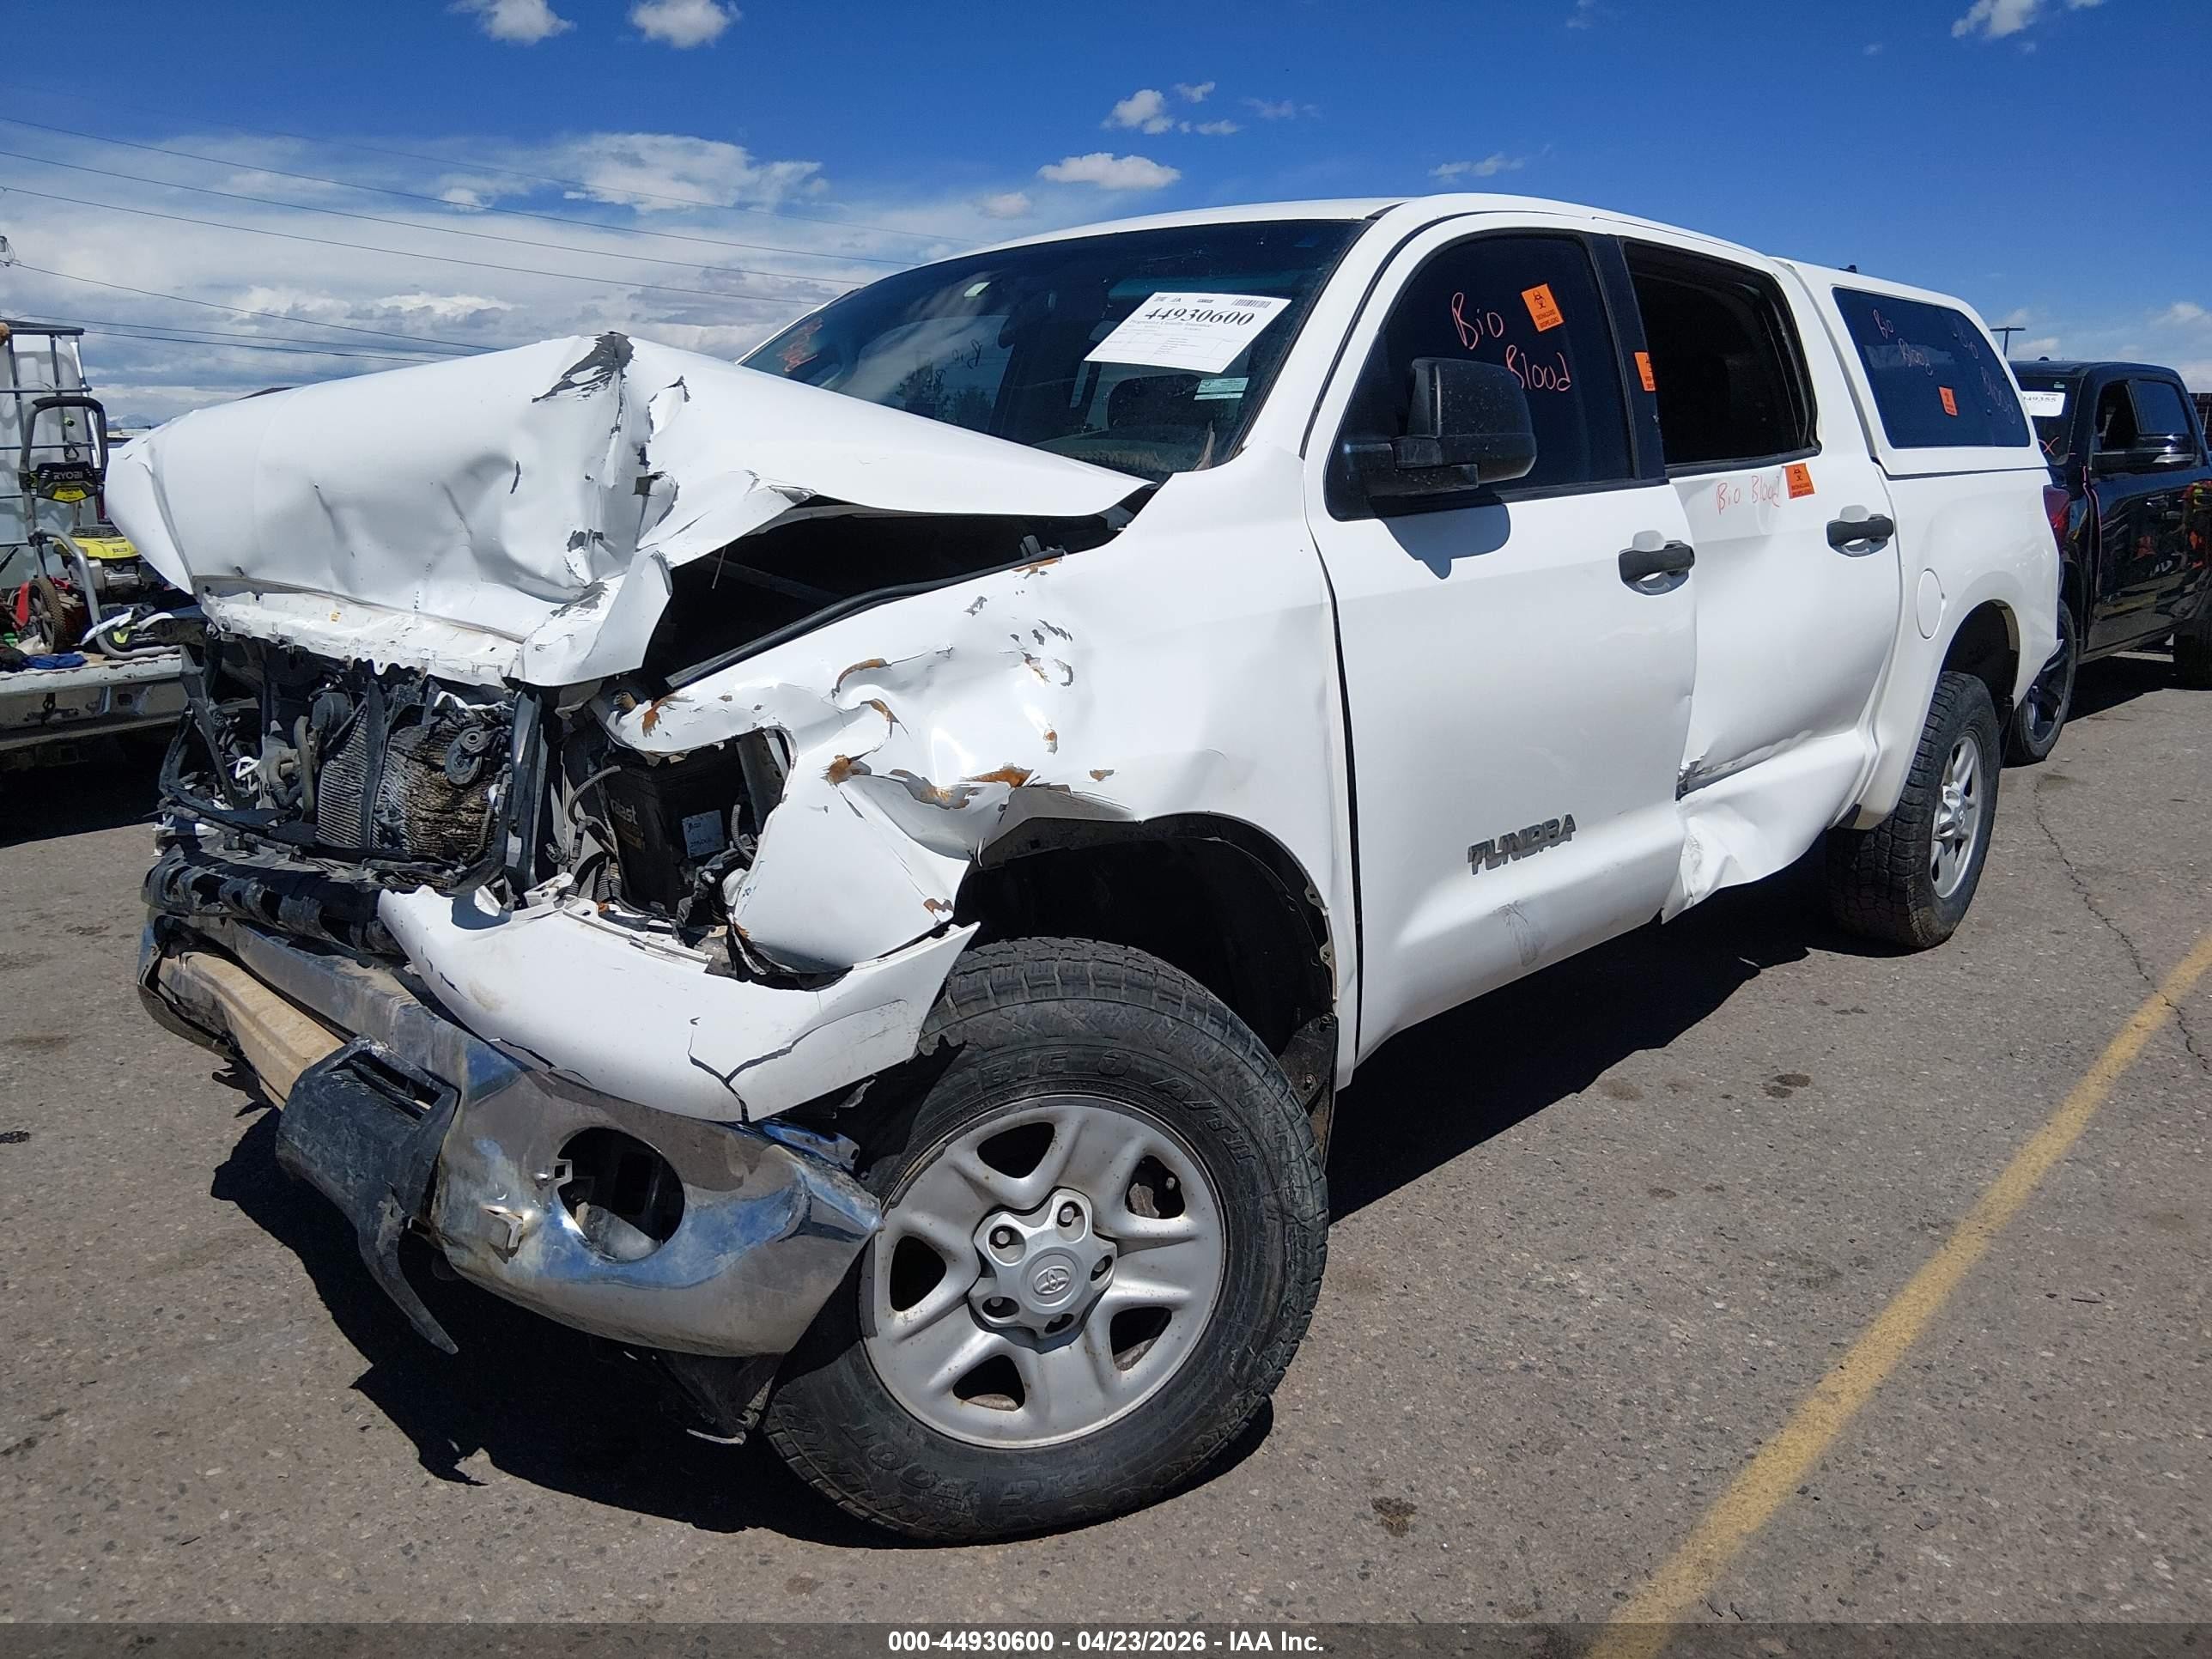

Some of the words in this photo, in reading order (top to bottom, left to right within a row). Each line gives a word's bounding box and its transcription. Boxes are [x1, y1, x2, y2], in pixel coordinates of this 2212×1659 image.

[1145, 307, 1255, 326] 44930600
[1451, 291, 1504, 350] Bio
[1505, 344, 1572, 392] Blood
[53, 471, 83, 480] RYOBI
[1717, 482, 1741, 515] Bio
[1752, 475, 1780, 508] Blood
[1467, 813, 1577, 876] TUNDRA
